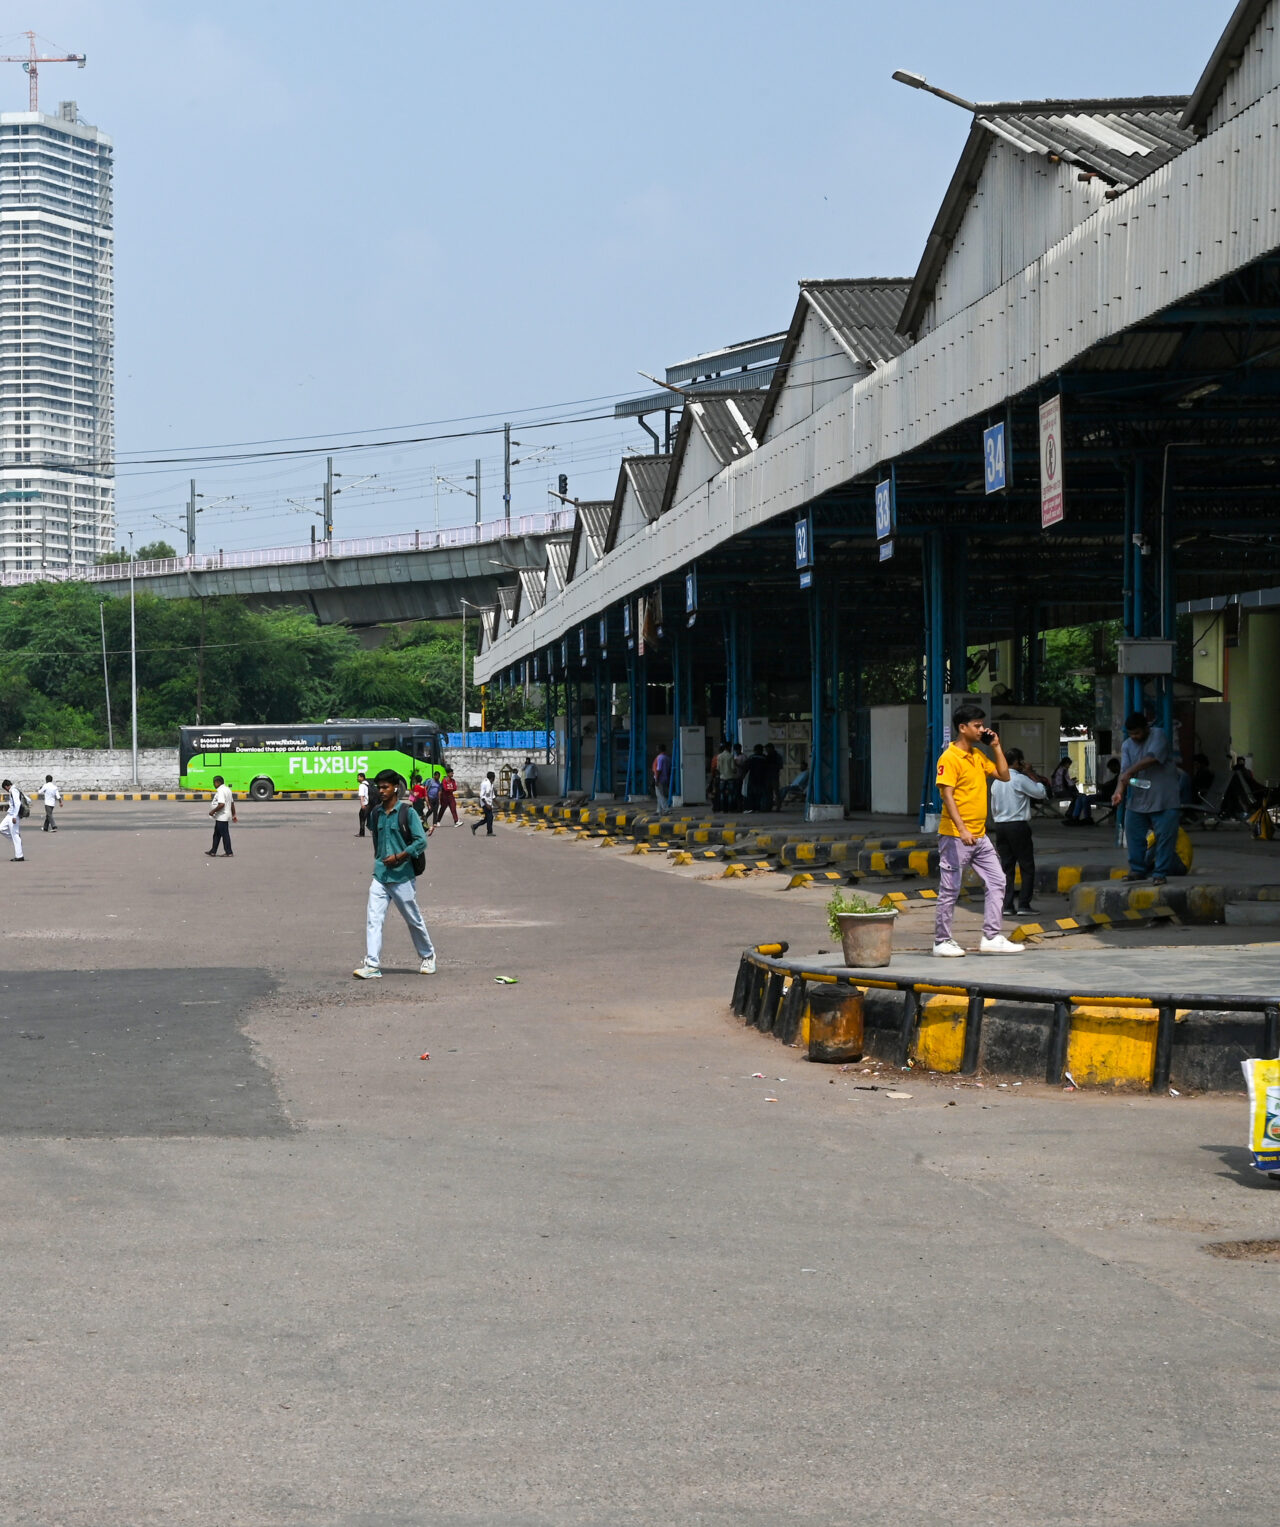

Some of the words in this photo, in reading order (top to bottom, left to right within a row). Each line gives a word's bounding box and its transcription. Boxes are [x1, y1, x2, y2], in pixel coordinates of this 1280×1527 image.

[987, 434, 1004, 483] 34
[878, 489, 889, 530] 33
[798, 527, 806, 560] 32
[289, 756, 368, 774] FLiXBUS
[938, 765, 945, 776] 3
